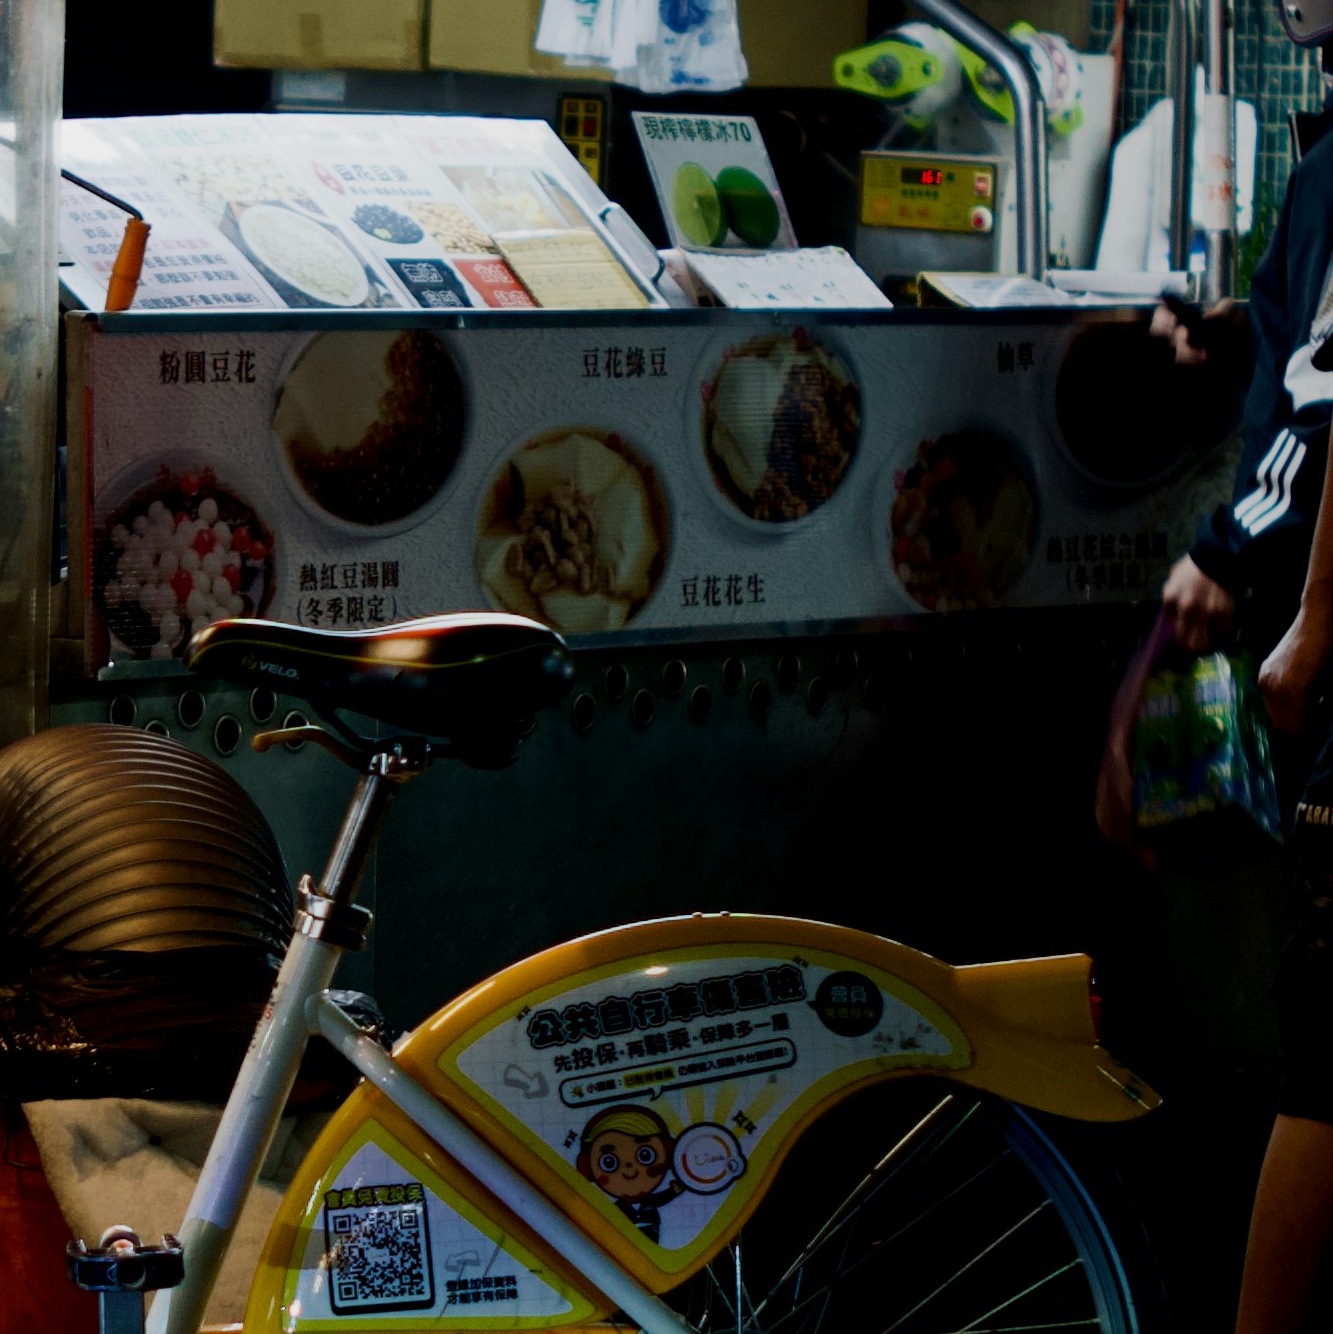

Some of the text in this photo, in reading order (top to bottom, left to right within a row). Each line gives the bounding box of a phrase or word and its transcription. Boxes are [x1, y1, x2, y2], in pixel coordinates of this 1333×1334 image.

[158, 349, 256, 385] 粉圓豆花
[582, 346, 669, 379] 豆花綠豆
[997, 341, 1034, 372] 仙草
[299, 560, 400, 592] 熱紅豆湯圓
[680, 573, 767, 607] 豆花花生
